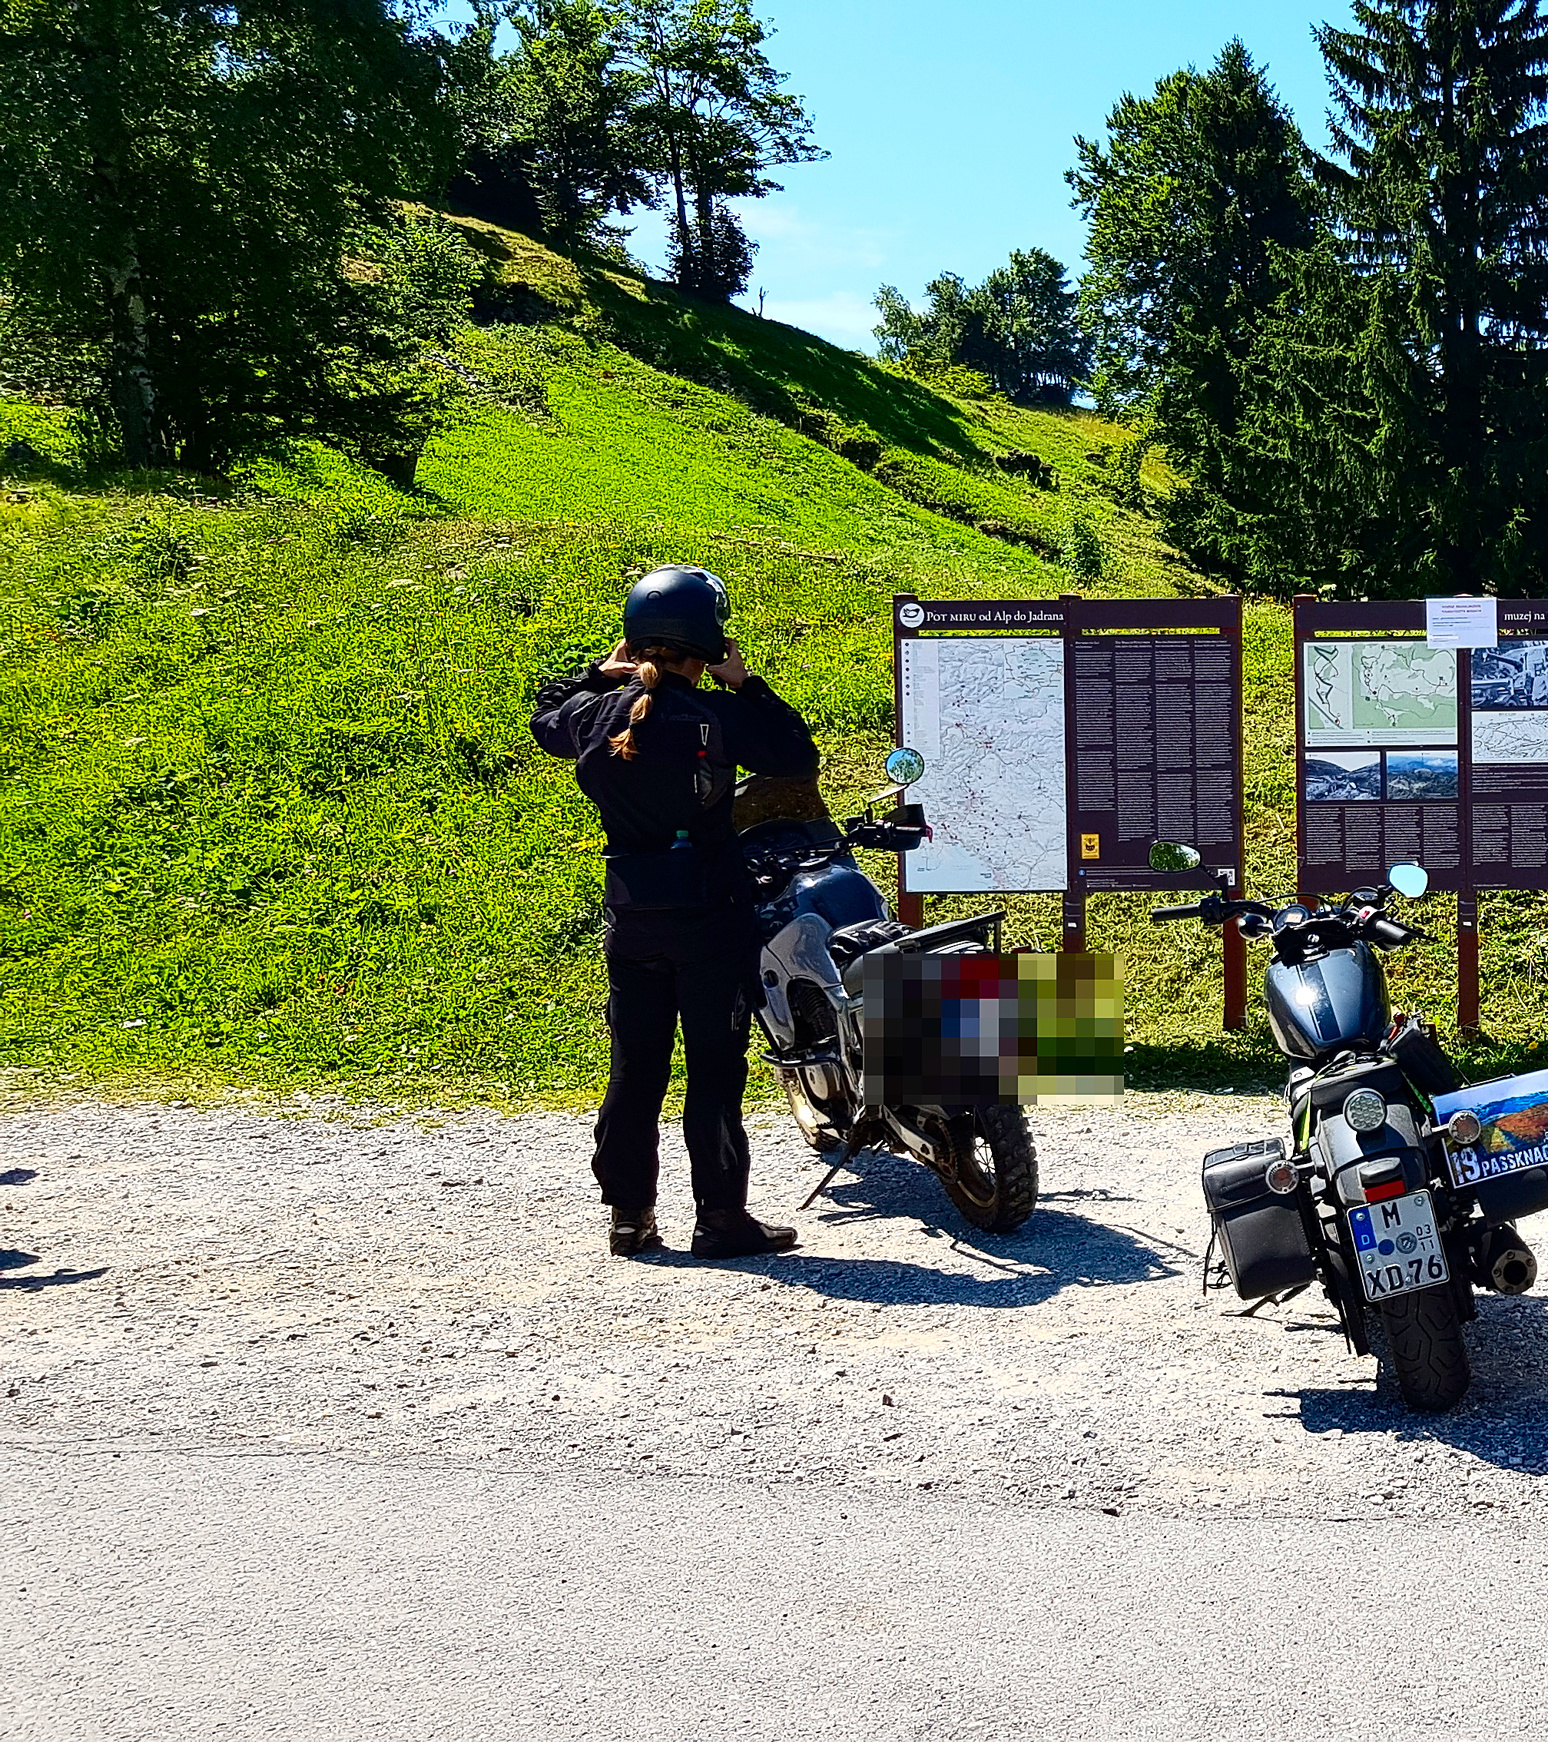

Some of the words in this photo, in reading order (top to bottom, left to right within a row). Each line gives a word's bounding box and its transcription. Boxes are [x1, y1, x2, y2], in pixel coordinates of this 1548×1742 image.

[926, 611, 947, 622] POT
[978, 610, 992, 622] od
[993, 610, 1012, 624] Alp
[1013, 610, 1026, 622] do
[1027, 610, 1064, 623] Jadrana
[1504, 611, 1532, 623] muzej
[1534, 612, 1545, 621] na
[1381, 1202, 1401, 1229] M
[1416, 1224, 1432, 1236] 03
[1361, 1234, 1370, 1245] D
[1420, 1239, 1435, 1251] 11
